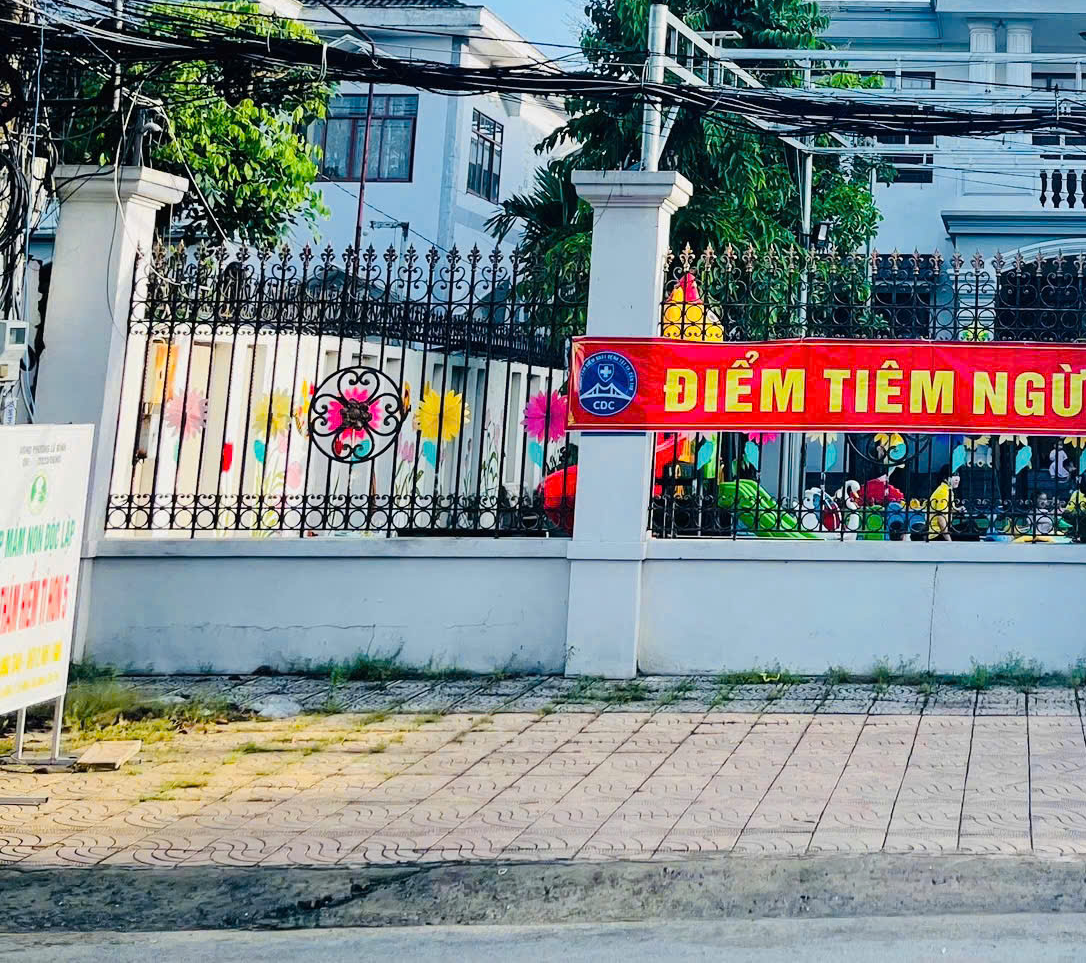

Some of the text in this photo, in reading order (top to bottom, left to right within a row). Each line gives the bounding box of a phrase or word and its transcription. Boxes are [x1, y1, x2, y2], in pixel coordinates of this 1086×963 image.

[663, 350, 806, 413] ĐIỂM
[823, 359, 955, 414] TIÊM
[592, 400, 616, 410] CDC
